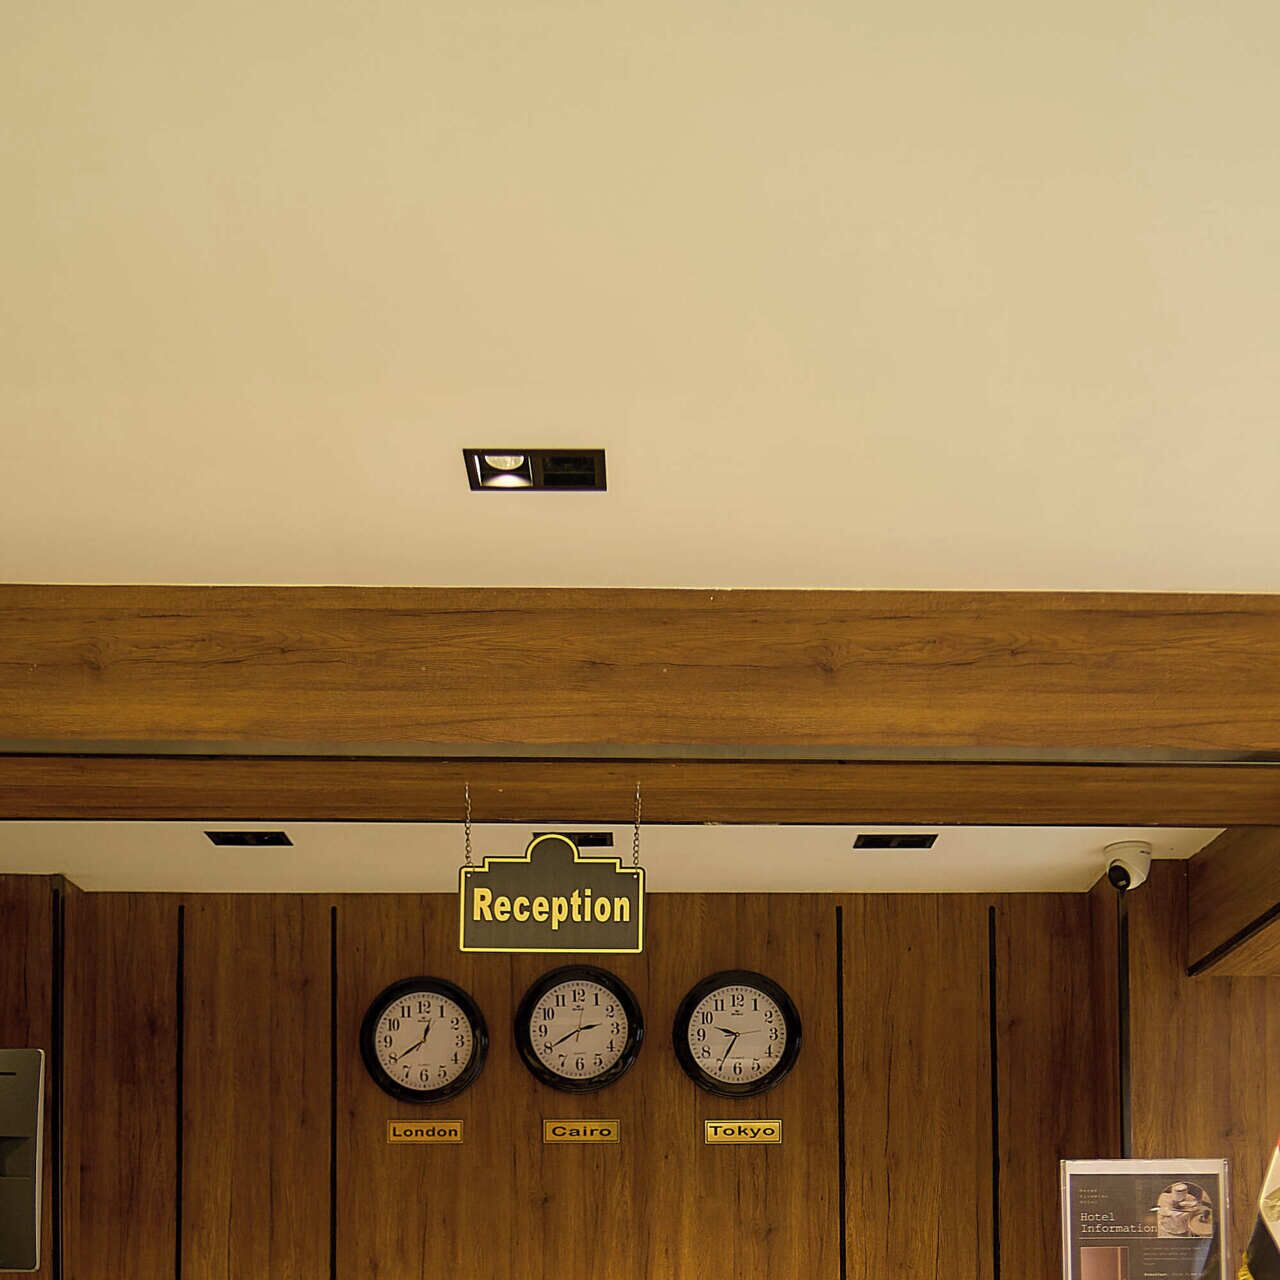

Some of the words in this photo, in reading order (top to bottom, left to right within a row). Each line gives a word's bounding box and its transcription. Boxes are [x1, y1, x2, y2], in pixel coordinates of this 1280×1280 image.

[473, 887, 630, 930] Reception
[555, 995, 566, 1007] 11
[572, 989, 586, 1002] 12
[594, 993, 600, 1006] 1
[730, 994, 744, 1007] 12
[417, 1001, 431, 1014] 12
[439, 1005, 445, 1018] 1
[606, 1005, 614, 1018] 2
[714, 1000, 724, 1011] 11
[752, 999, 758, 1011] 1
[401, 1006, 411, 1018] 11
[543, 1008, 554, 1020] 10
[701, 1011, 713, 1024] 10
[764, 1010, 773, 1023] 2
[388, 1018, 400, 1031] 10
[451, 1017, 459, 1030] 2
[611, 1022, 620, 1035] 3
[539, 1025, 547, 1037] 9
[697, 1028, 706, 1041] 9
[769, 1027, 778, 1041] 3
[384, 1035, 392, 1048] 9
[456, 1034, 464, 1047] 3
[606, 1039, 616, 1052] 4
[544, 1042, 553, 1055] 8
[702, 1045, 711, 1058] 8
[764, 1045, 773, 1057] 4
[389, 1052, 398, 1065] 8
[451, 1052, 459, 1064] 4
[558, 1054, 567, 1067] 7
[576, 1057, 584, 1070] 6
[593, 1053, 602, 1066] 5
[402, 1065, 411, 1078] 7
[438, 1065, 447, 1078] 5
[716, 1058, 724, 1072] 7
[733, 1062, 742, 1075] 6
[752, 1058, 760, 1072] 5
[420, 1068, 429, 1082] 6
[392, 1125, 459, 1138] London
[551, 1125, 612, 1137] Cairo
[708, 1125, 776, 1139] Tokyo
[1080, 1212, 1115, 1222] Hotel
[1080, 1223, 1158, 1233] Information
